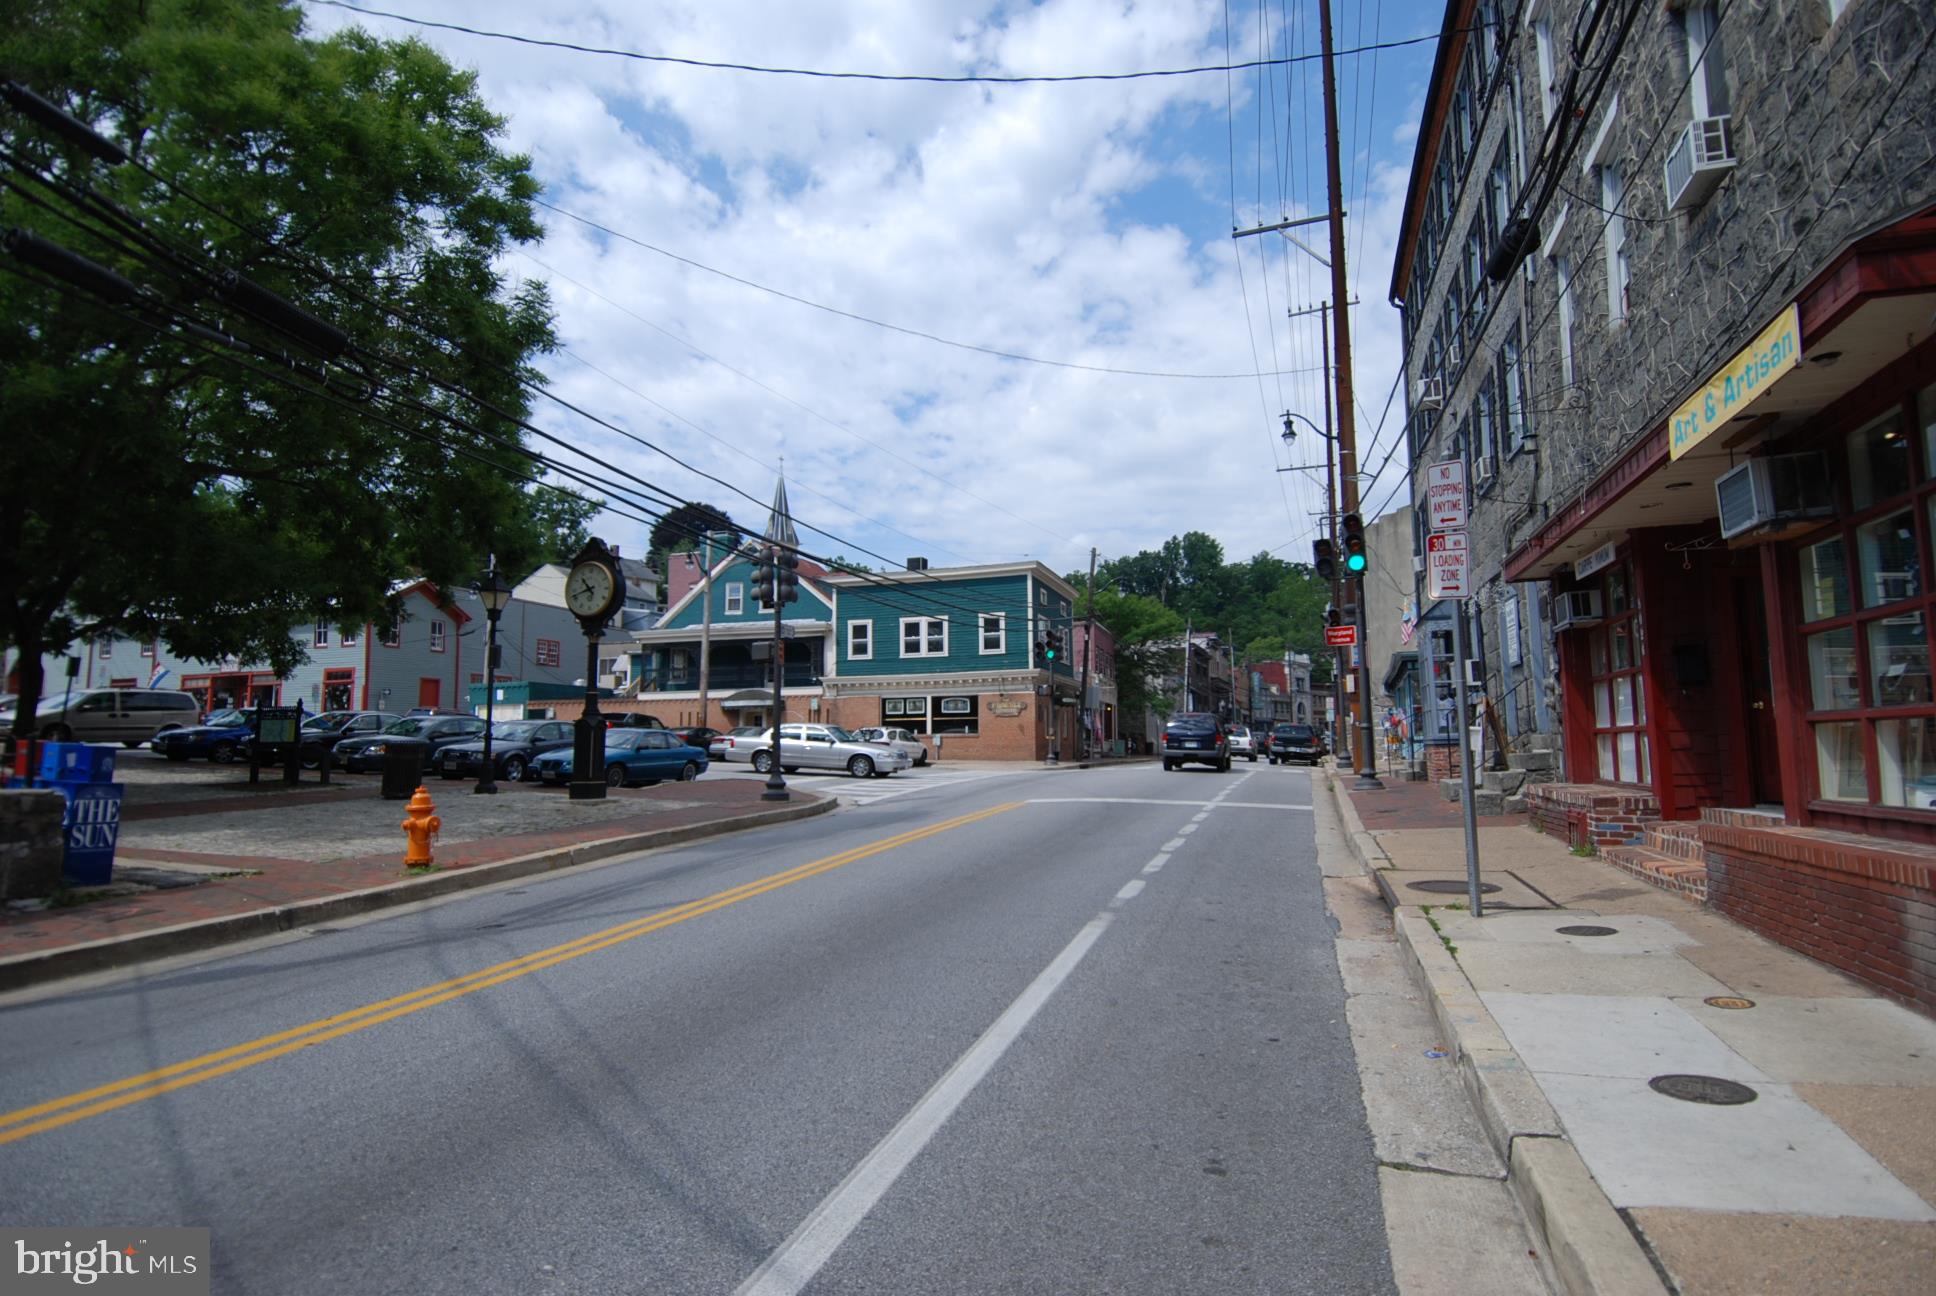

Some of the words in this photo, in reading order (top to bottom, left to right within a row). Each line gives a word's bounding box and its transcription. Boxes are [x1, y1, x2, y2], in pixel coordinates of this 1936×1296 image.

[1674, 410, 1699, 449] Art
[1704, 391, 1717, 423] &
[1723, 330, 1794, 409] Artisan
[1440, 466, 1450, 480] NO
[1430, 482, 1463, 499] STOPPING
[1433, 498, 1462, 514] ANYTIME
[1432, 537, 1445, 551] 30
[1433, 553, 1464, 568] LOADING
[1440, 568, 1460, 582] ZONE
[73, 799, 121, 823] THE
[70, 823, 117, 849] SUN
